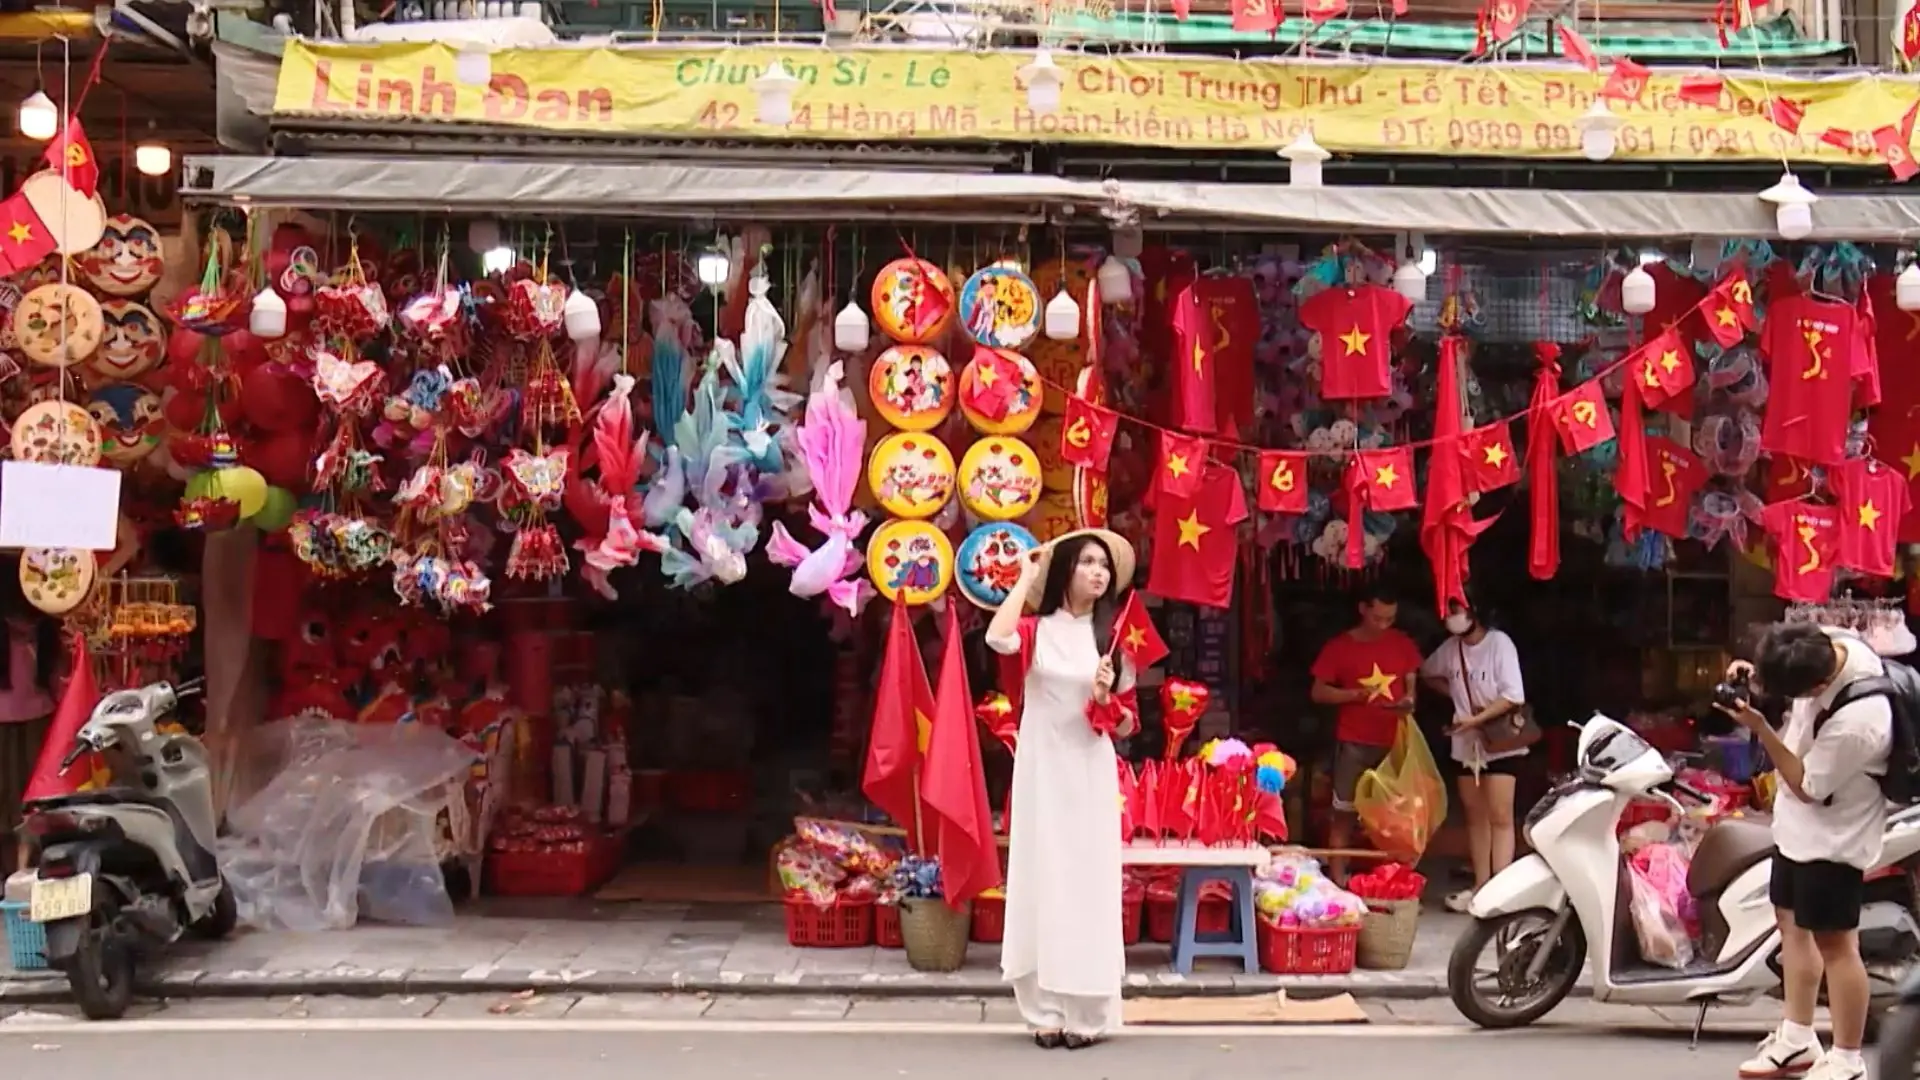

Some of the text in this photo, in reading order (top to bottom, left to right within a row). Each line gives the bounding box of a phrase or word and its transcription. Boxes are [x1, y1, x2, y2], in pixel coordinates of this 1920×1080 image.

[311, 60, 613, 121] Linh Đan
[1077, 64, 1165, 97] Chơi
[1178, 70, 1281, 111] Trung
[1296, 75, 1362, 106] Thu
[1453, 71, 1508, 107] Tết
[700, 101, 741, 131] 42
[828, 103, 917, 136] Hàng
[1448, 119, 1522, 150] 0989
